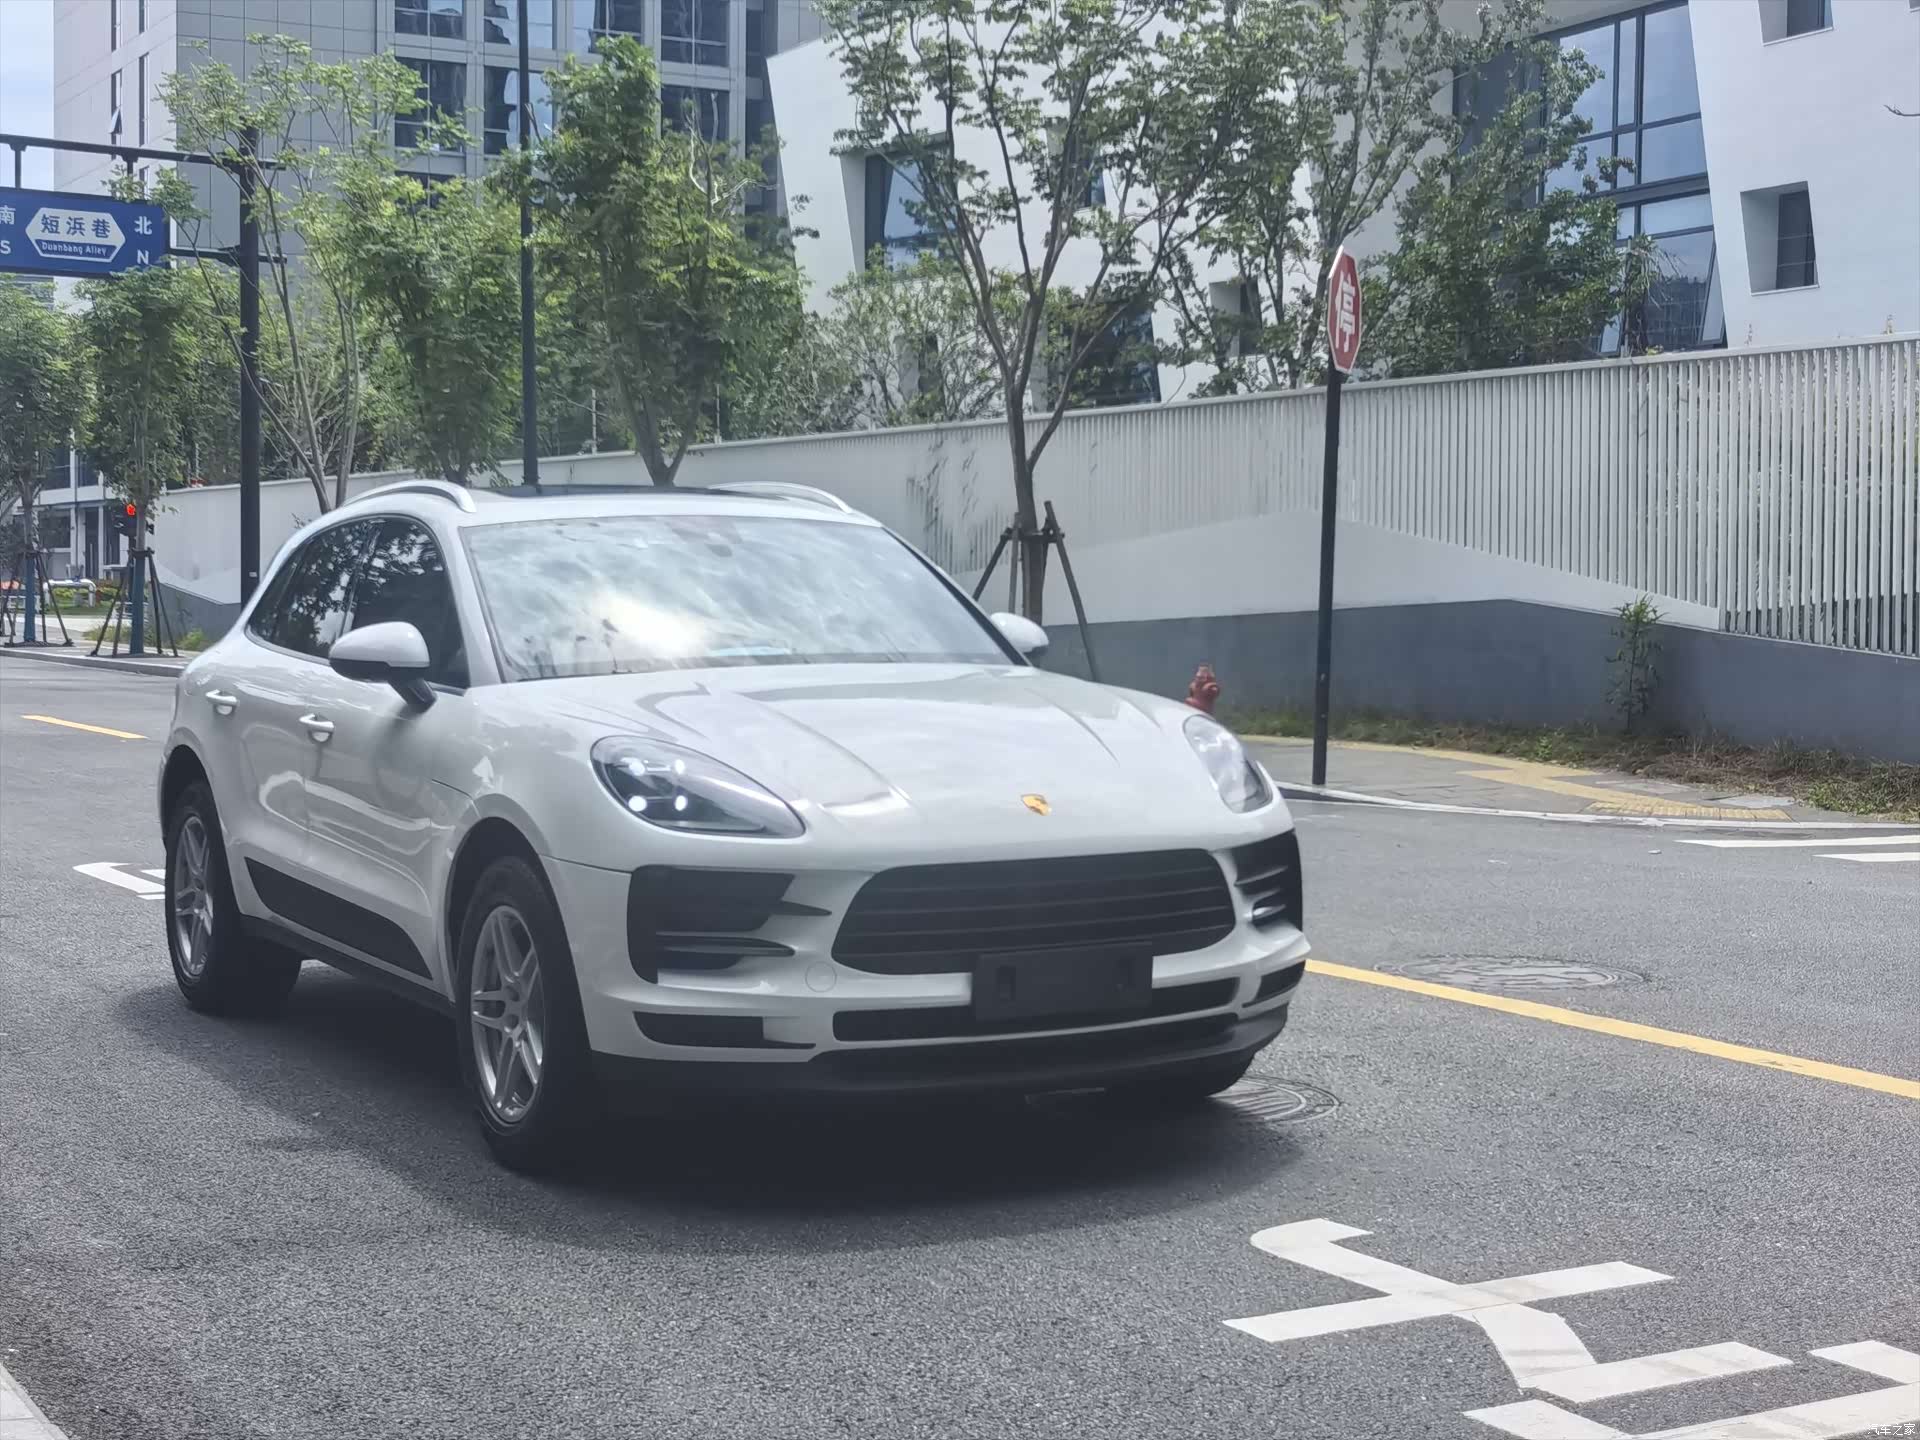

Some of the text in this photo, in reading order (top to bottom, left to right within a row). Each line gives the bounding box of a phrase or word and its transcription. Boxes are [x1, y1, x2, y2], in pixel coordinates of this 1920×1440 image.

[0, 204, 16, 225] 南
[41, 213, 111, 239] 短浜巷
[134, 215, 153, 235] 北
[0, 239, 11, 255] S
[86, 245, 107, 256] Alley
[136, 249, 149, 265] N
[1334, 269, 1356, 353] 停
